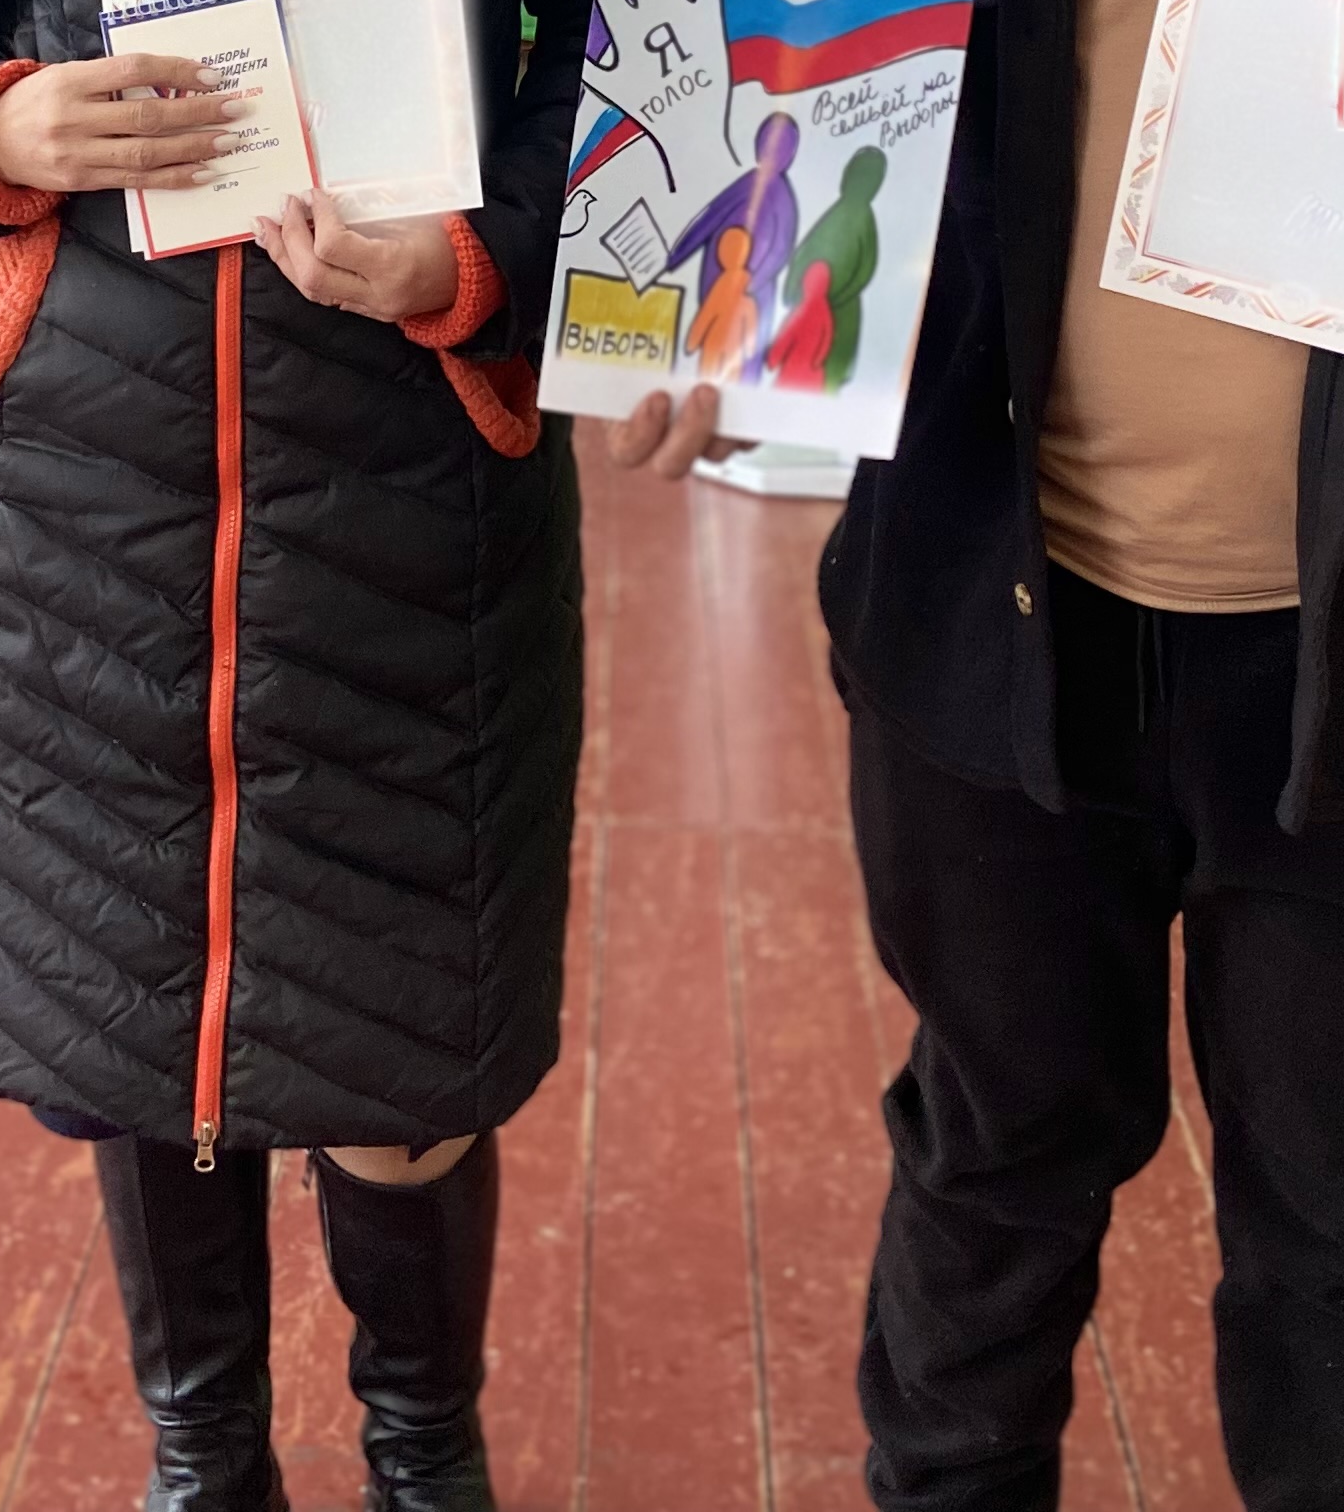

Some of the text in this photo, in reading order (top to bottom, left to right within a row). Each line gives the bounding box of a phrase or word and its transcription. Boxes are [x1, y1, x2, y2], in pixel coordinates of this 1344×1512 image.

[201, 48, 250, 66] ВЫБОРЫ
[644, 21, 693, 78] Я
[212, 58, 268, 77] ЗИДЕНТА
[922, 71, 956, 95] на
[812, 78, 879, 125] Всей
[231, 127, 261, 139] ИЛА
[235, 137, 280, 155] РОССИЮ
[565, 322, 668, 364] ВЫБОРЫ
